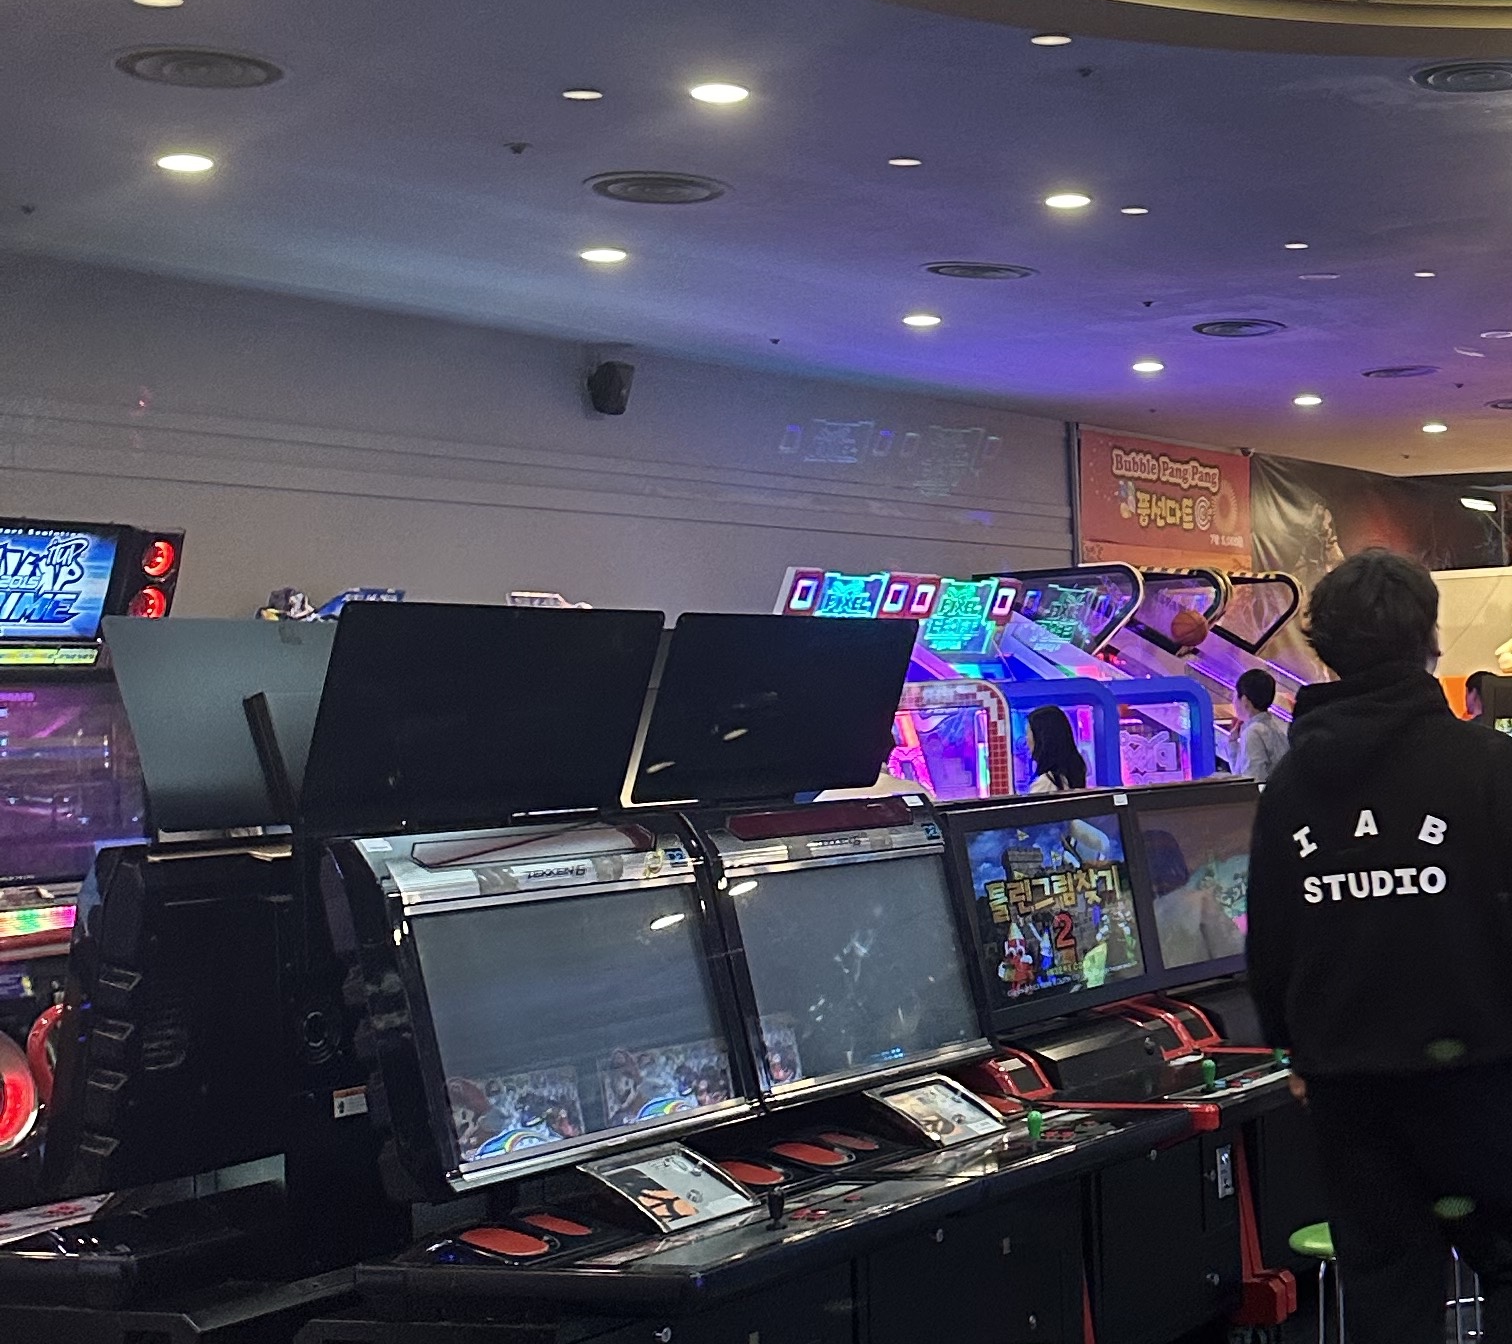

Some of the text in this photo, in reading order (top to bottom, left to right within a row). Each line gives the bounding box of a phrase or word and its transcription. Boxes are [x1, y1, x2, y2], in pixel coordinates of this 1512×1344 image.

[1115, 455, 1219, 490] Bubble Pang Pang
[1136, 492, 1195, 530] 풍선다트
[0, 591, 82, 623] IME
[1303, 865, 1447, 904] STUDIO
[1053, 911, 1077, 949] 2
